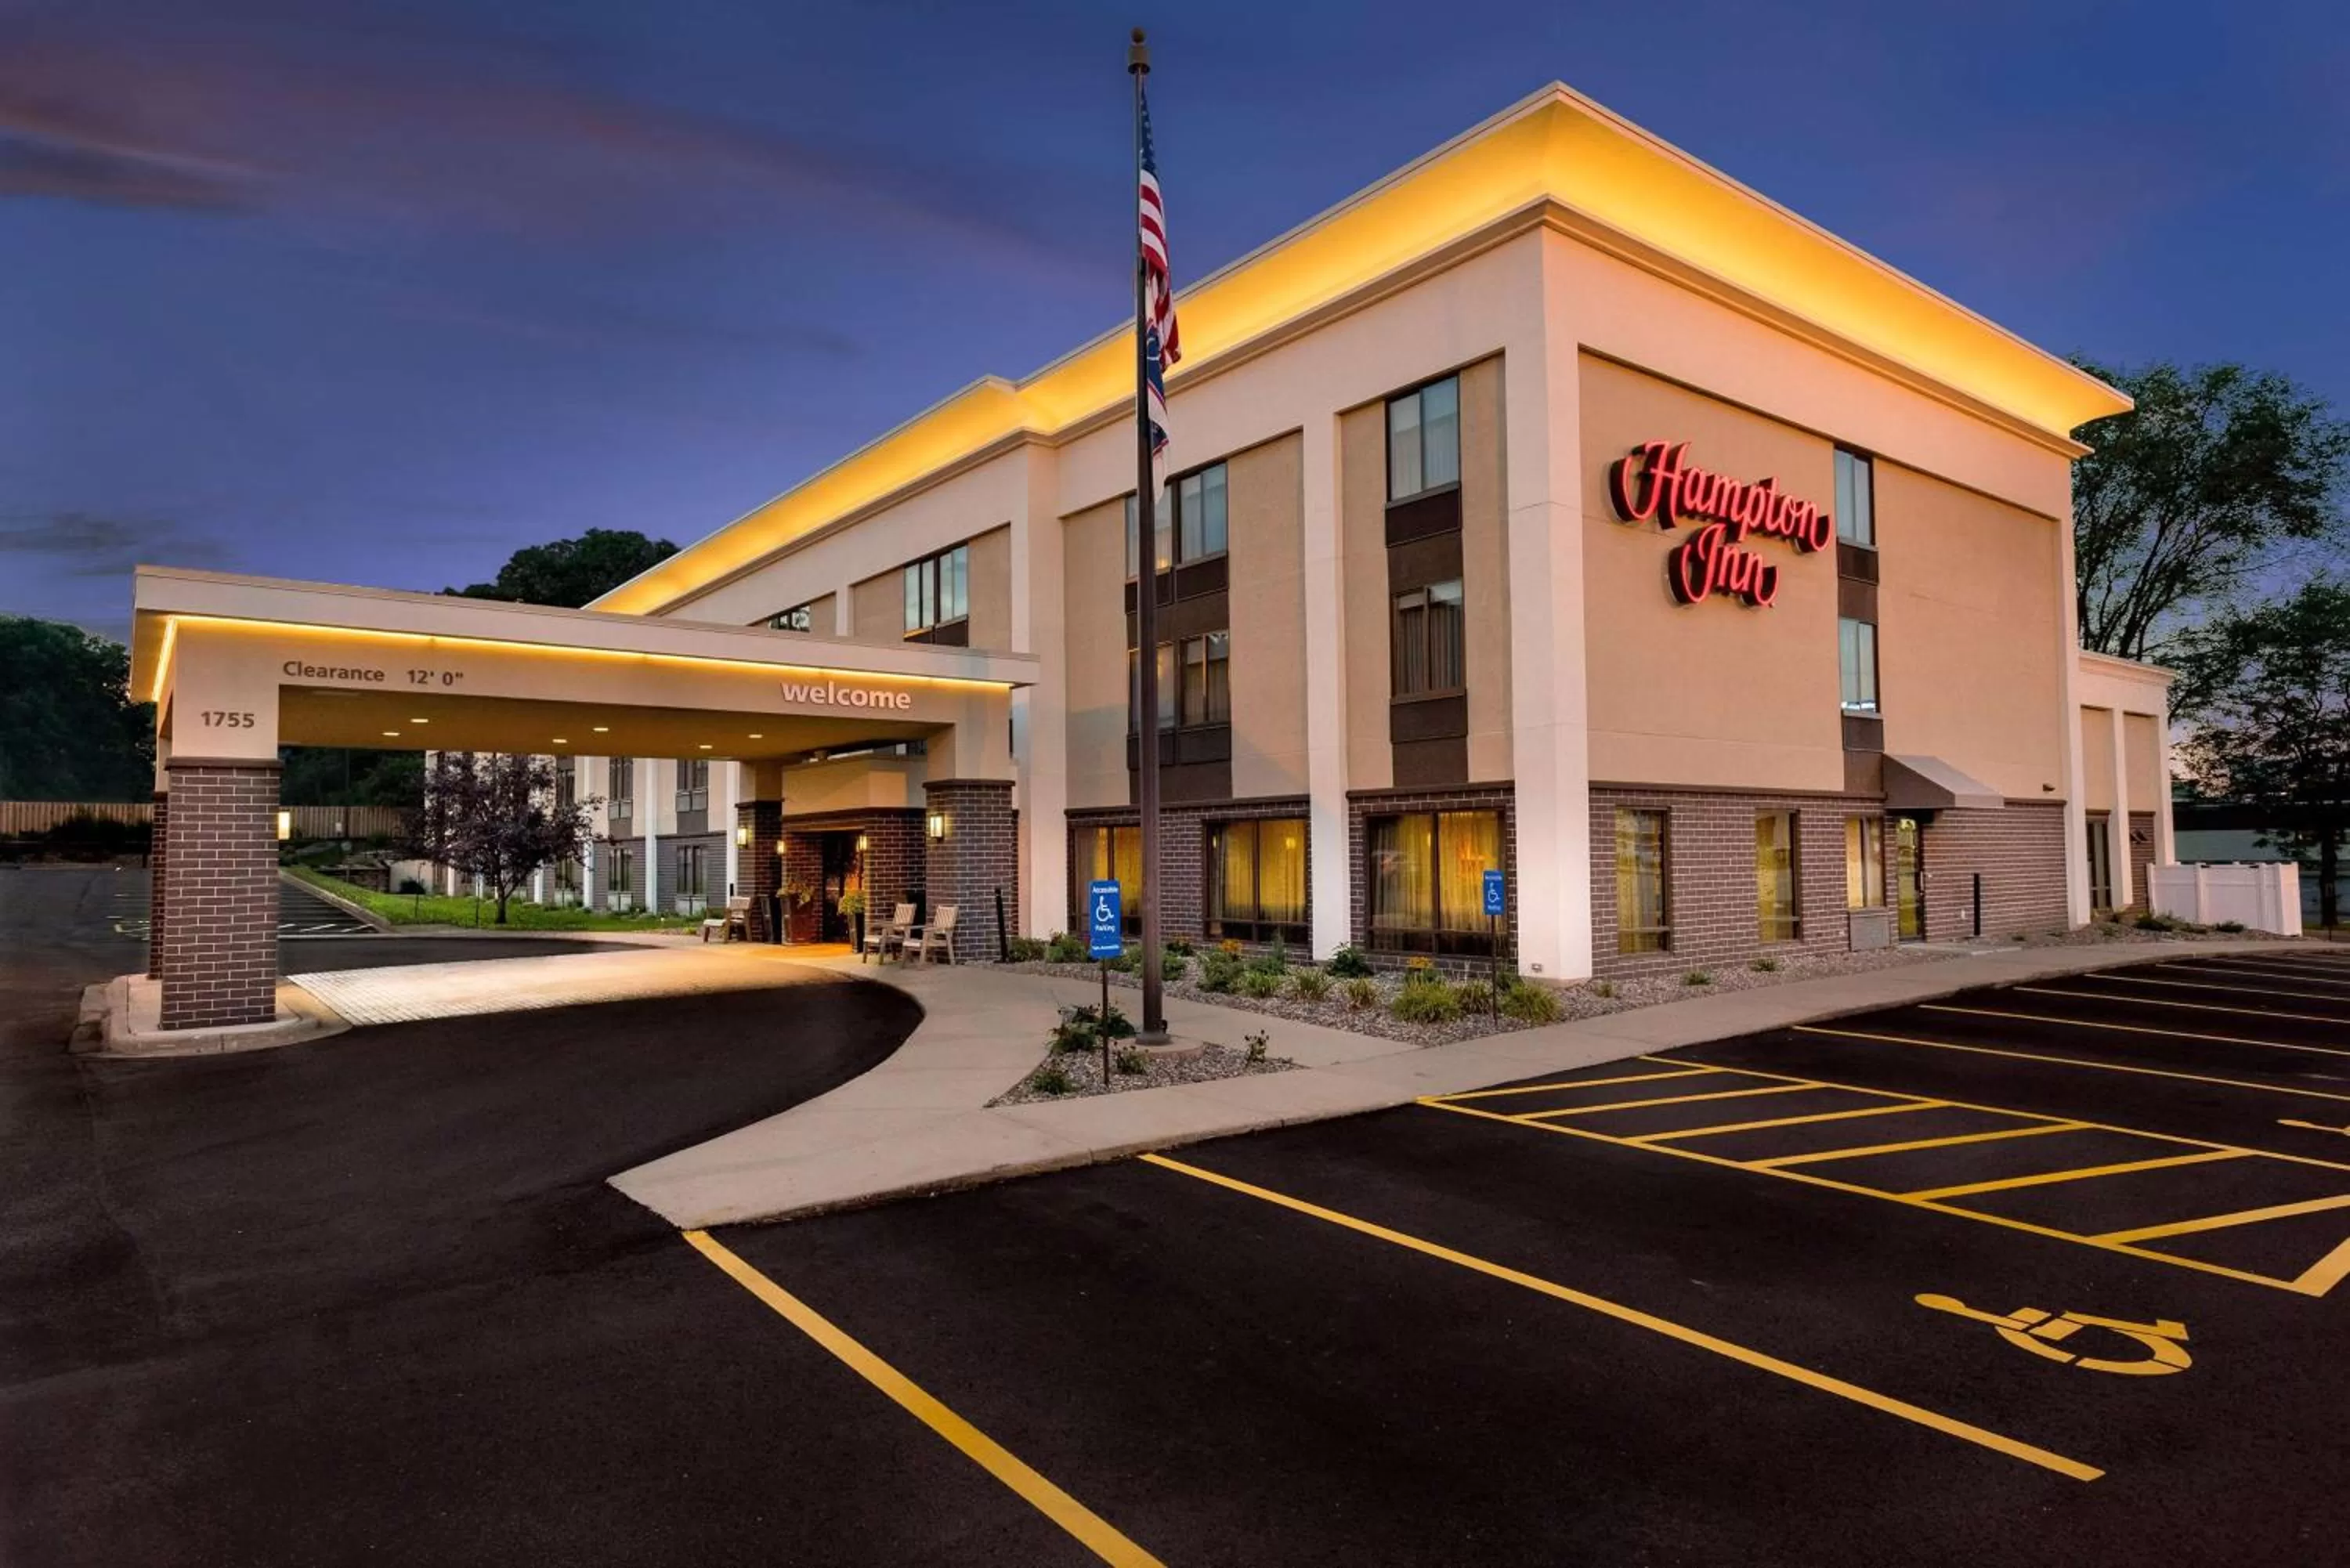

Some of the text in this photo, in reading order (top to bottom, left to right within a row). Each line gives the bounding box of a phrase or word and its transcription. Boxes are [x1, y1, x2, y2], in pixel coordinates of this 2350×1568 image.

[1612, 440, 1831, 552] Hampton
[1672, 522, 1780, 607] Inn
[283, 660, 385, 681] Clearance
[407, 669, 435, 685] 12'
[780, 680, 912, 710] welcome
[201, 710, 255, 728] 1755
